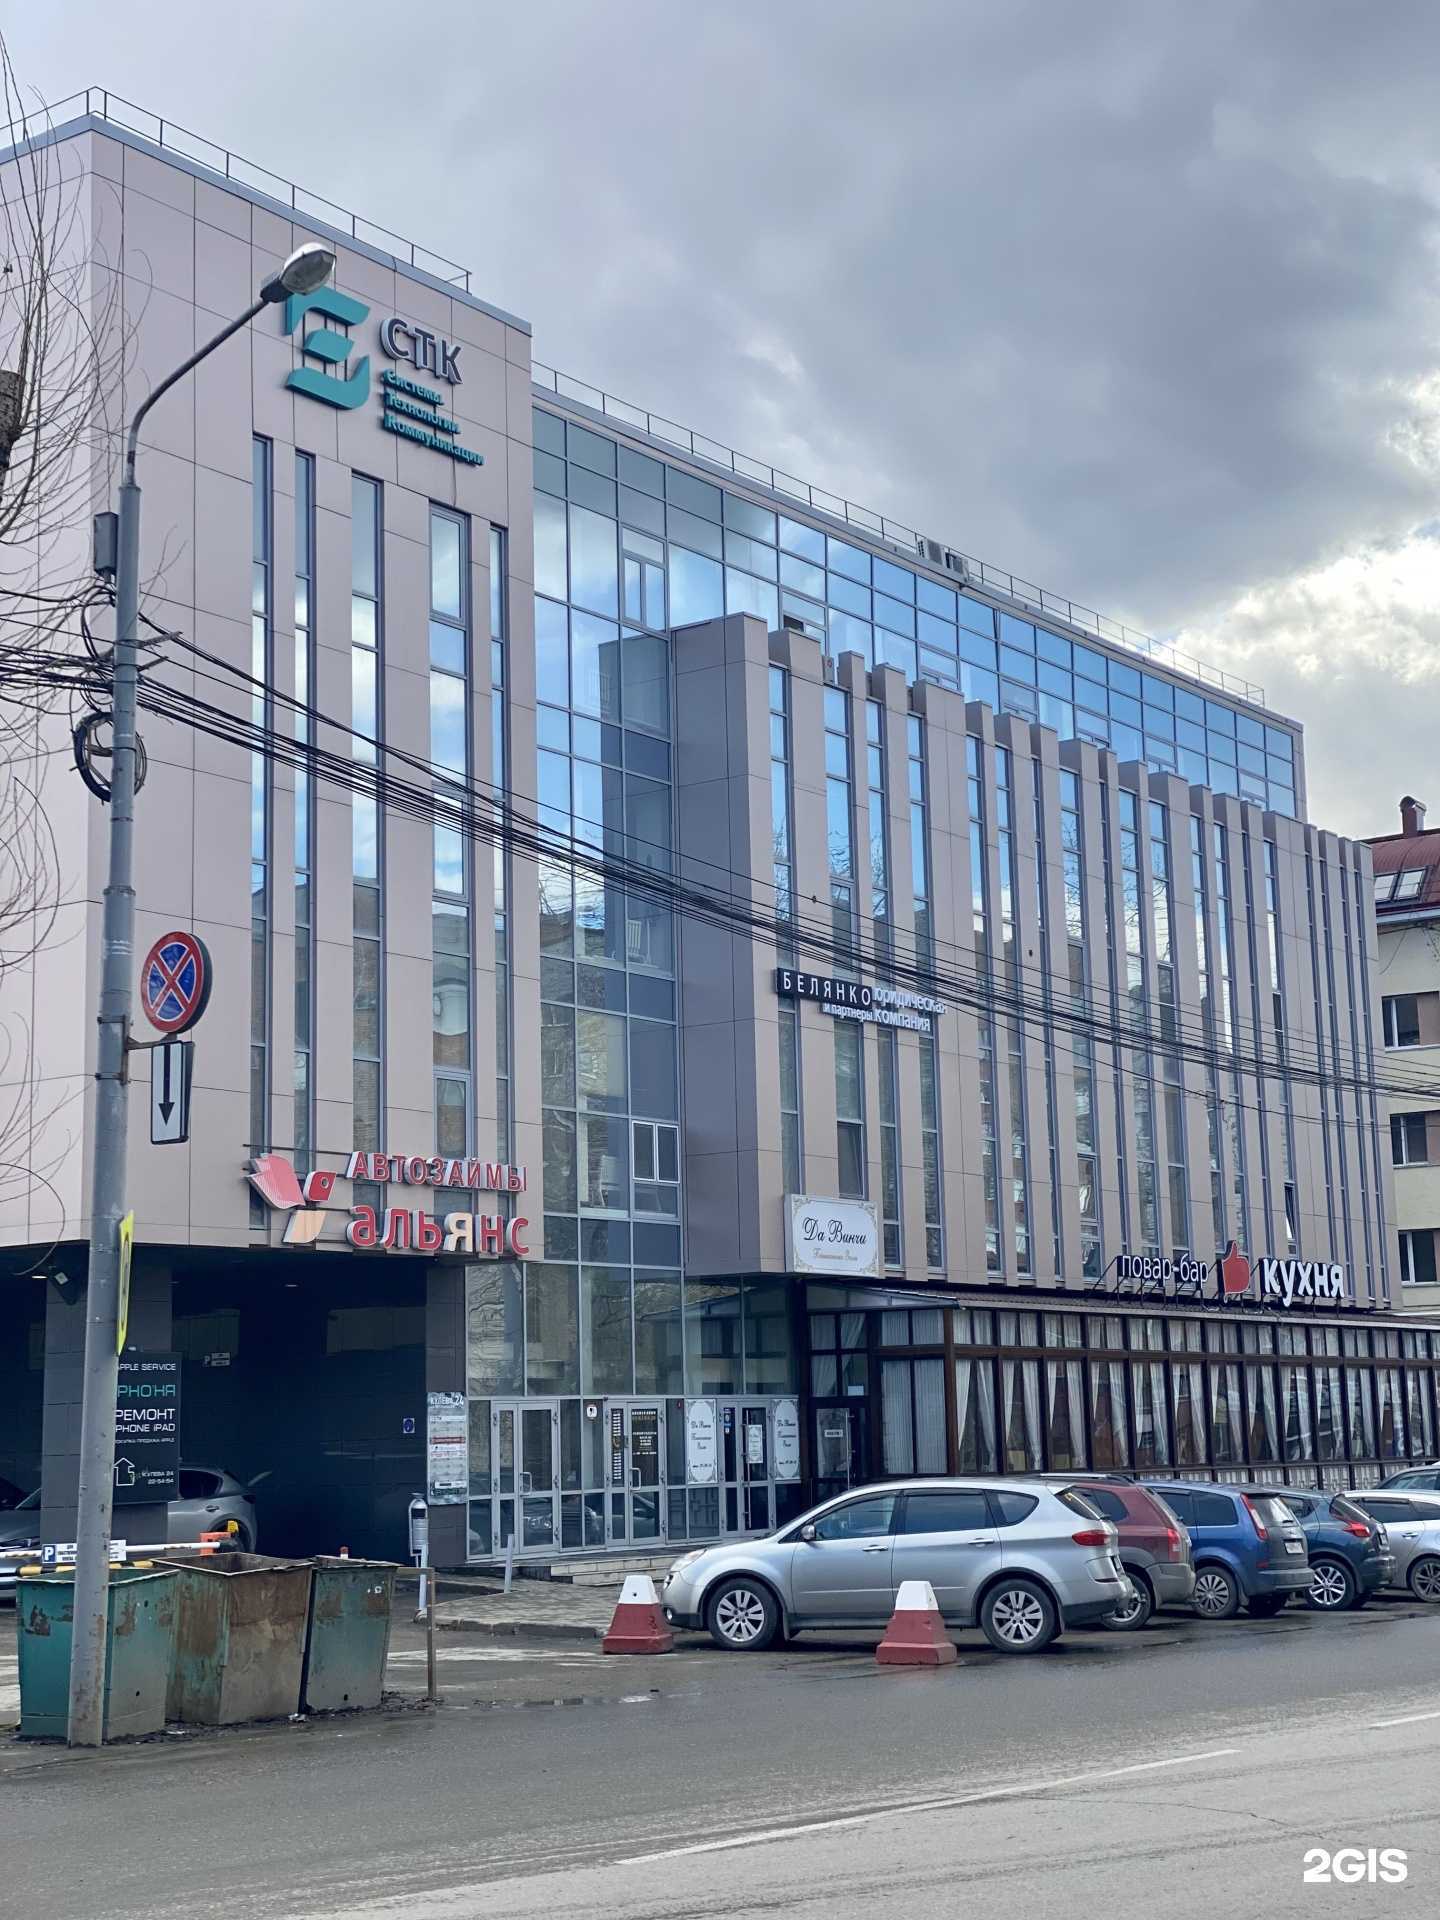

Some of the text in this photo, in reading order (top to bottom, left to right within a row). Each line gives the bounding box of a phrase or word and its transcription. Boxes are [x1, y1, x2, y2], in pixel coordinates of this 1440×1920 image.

[382, 317, 462, 384] СТК
[783, 971, 871, 1006] БЕЛЯНКО
[347, 1151, 528, 1192] АВТОЗАЙМЫ
[802, 1217, 825, 1242] Да
[1122, 1253, 1209, 1288] повар-бар
[118, 1363, 176, 1371] PPLE SERVICE
[115, 1408, 176, 1421] РЕМОНТ
[115, 1423, 150, 1433] PHONE
